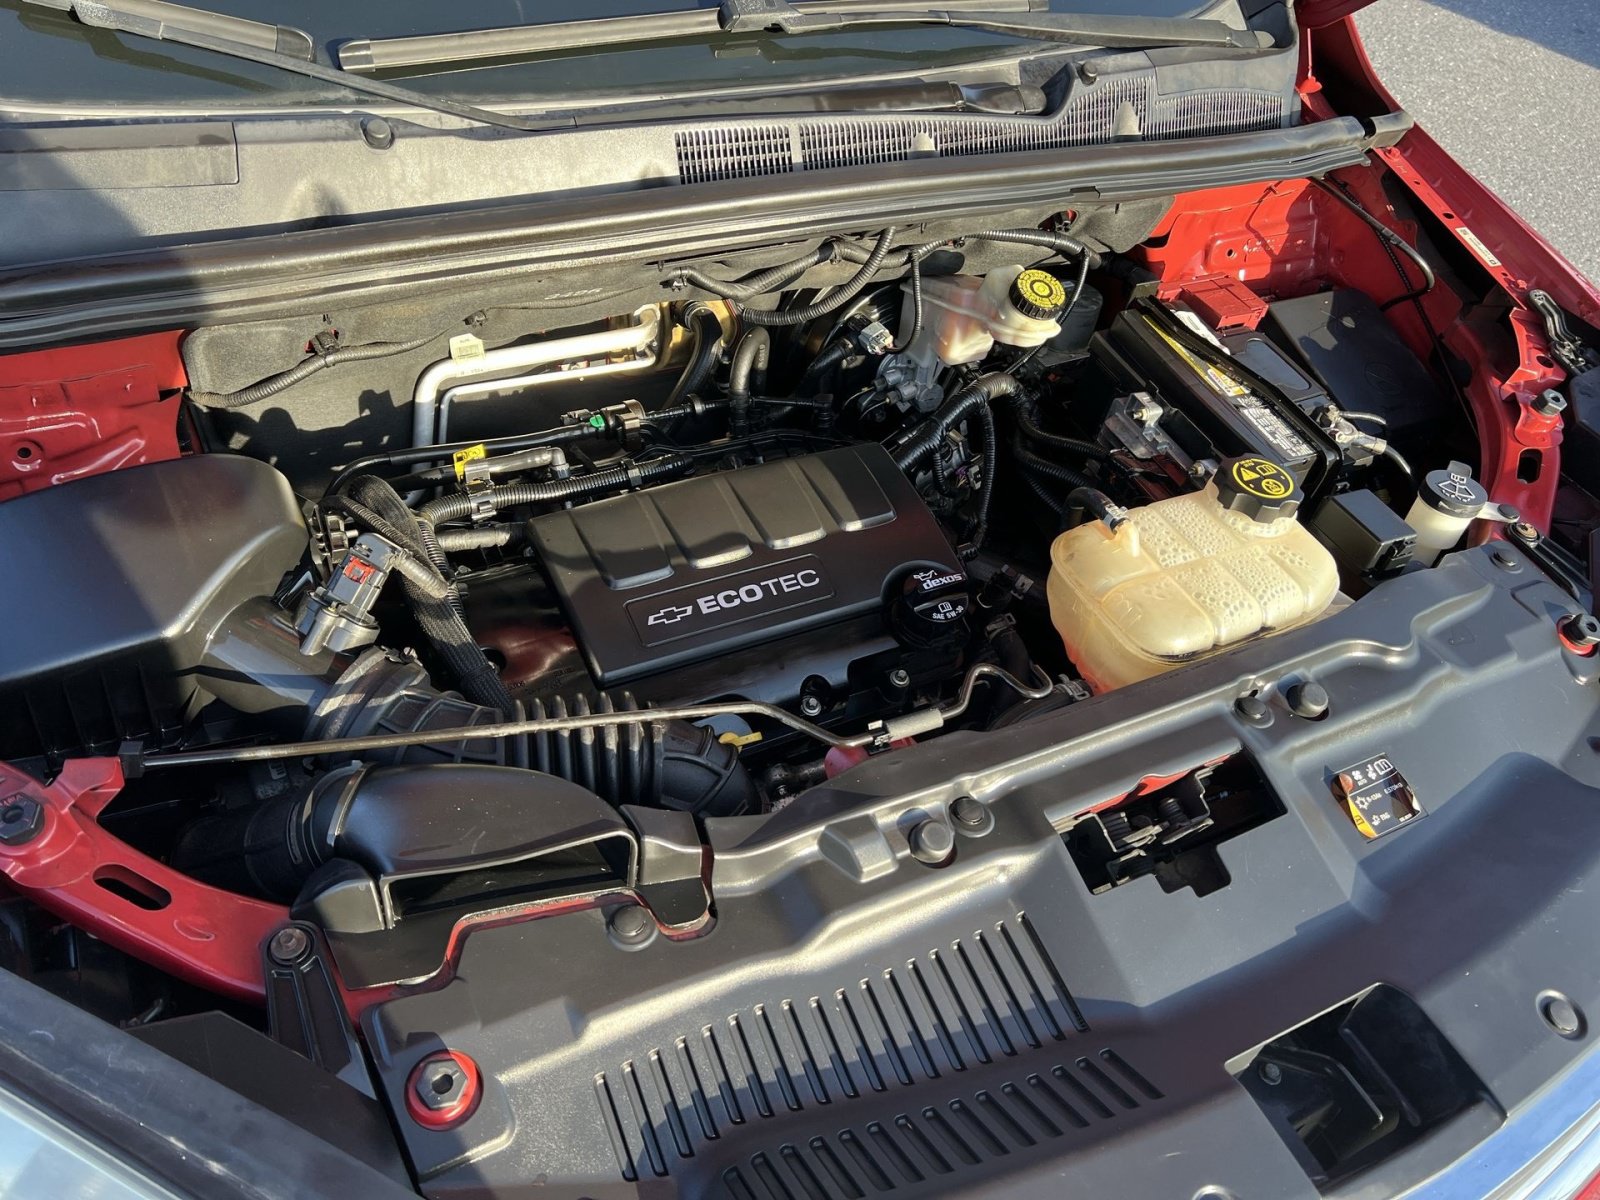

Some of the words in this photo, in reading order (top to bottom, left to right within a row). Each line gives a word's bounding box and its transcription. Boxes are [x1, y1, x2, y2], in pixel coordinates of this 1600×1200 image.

[922, 573, 963, 590] dexos
[697, 569, 820, 615] ECOTEC
[932, 612, 945, 620] SAE
